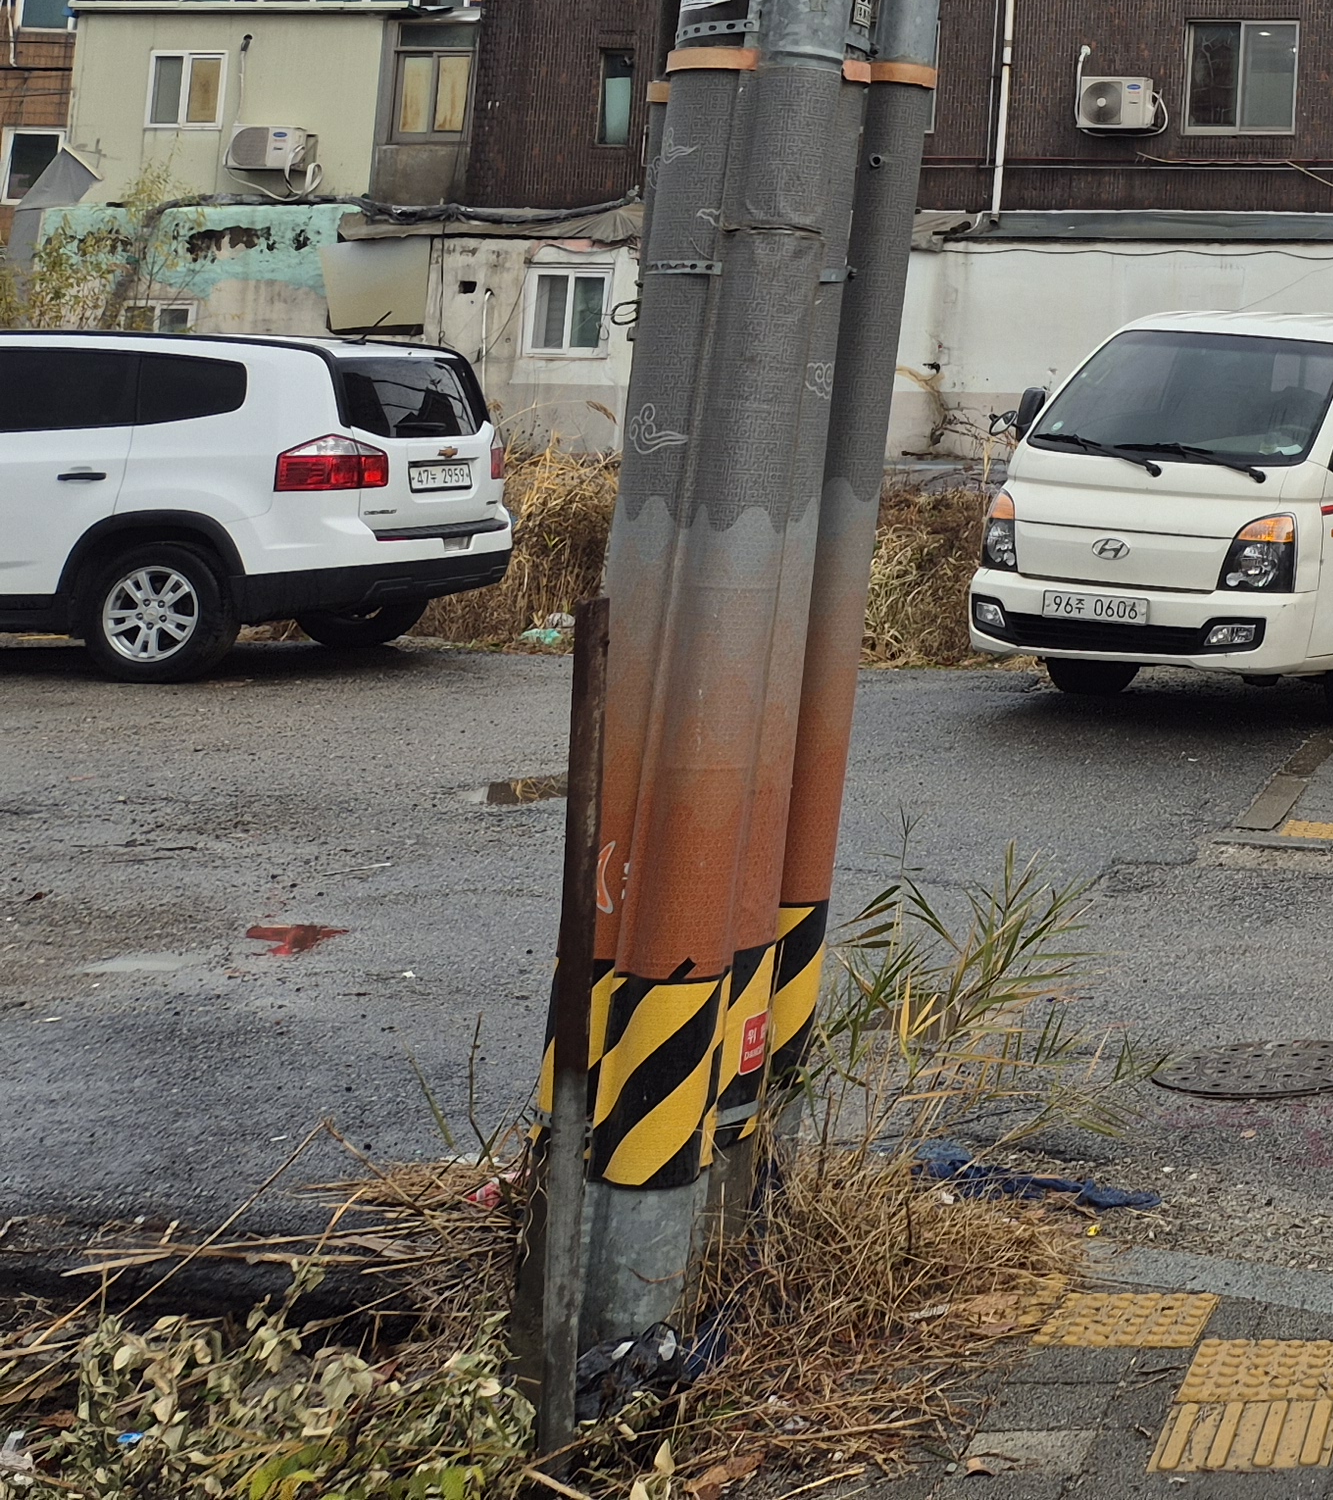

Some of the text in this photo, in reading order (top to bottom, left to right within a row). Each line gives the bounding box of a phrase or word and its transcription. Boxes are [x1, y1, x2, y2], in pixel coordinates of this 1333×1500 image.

[441, 468, 465, 484] 2959
[1053, 595, 1138, 620] 96주 0606
